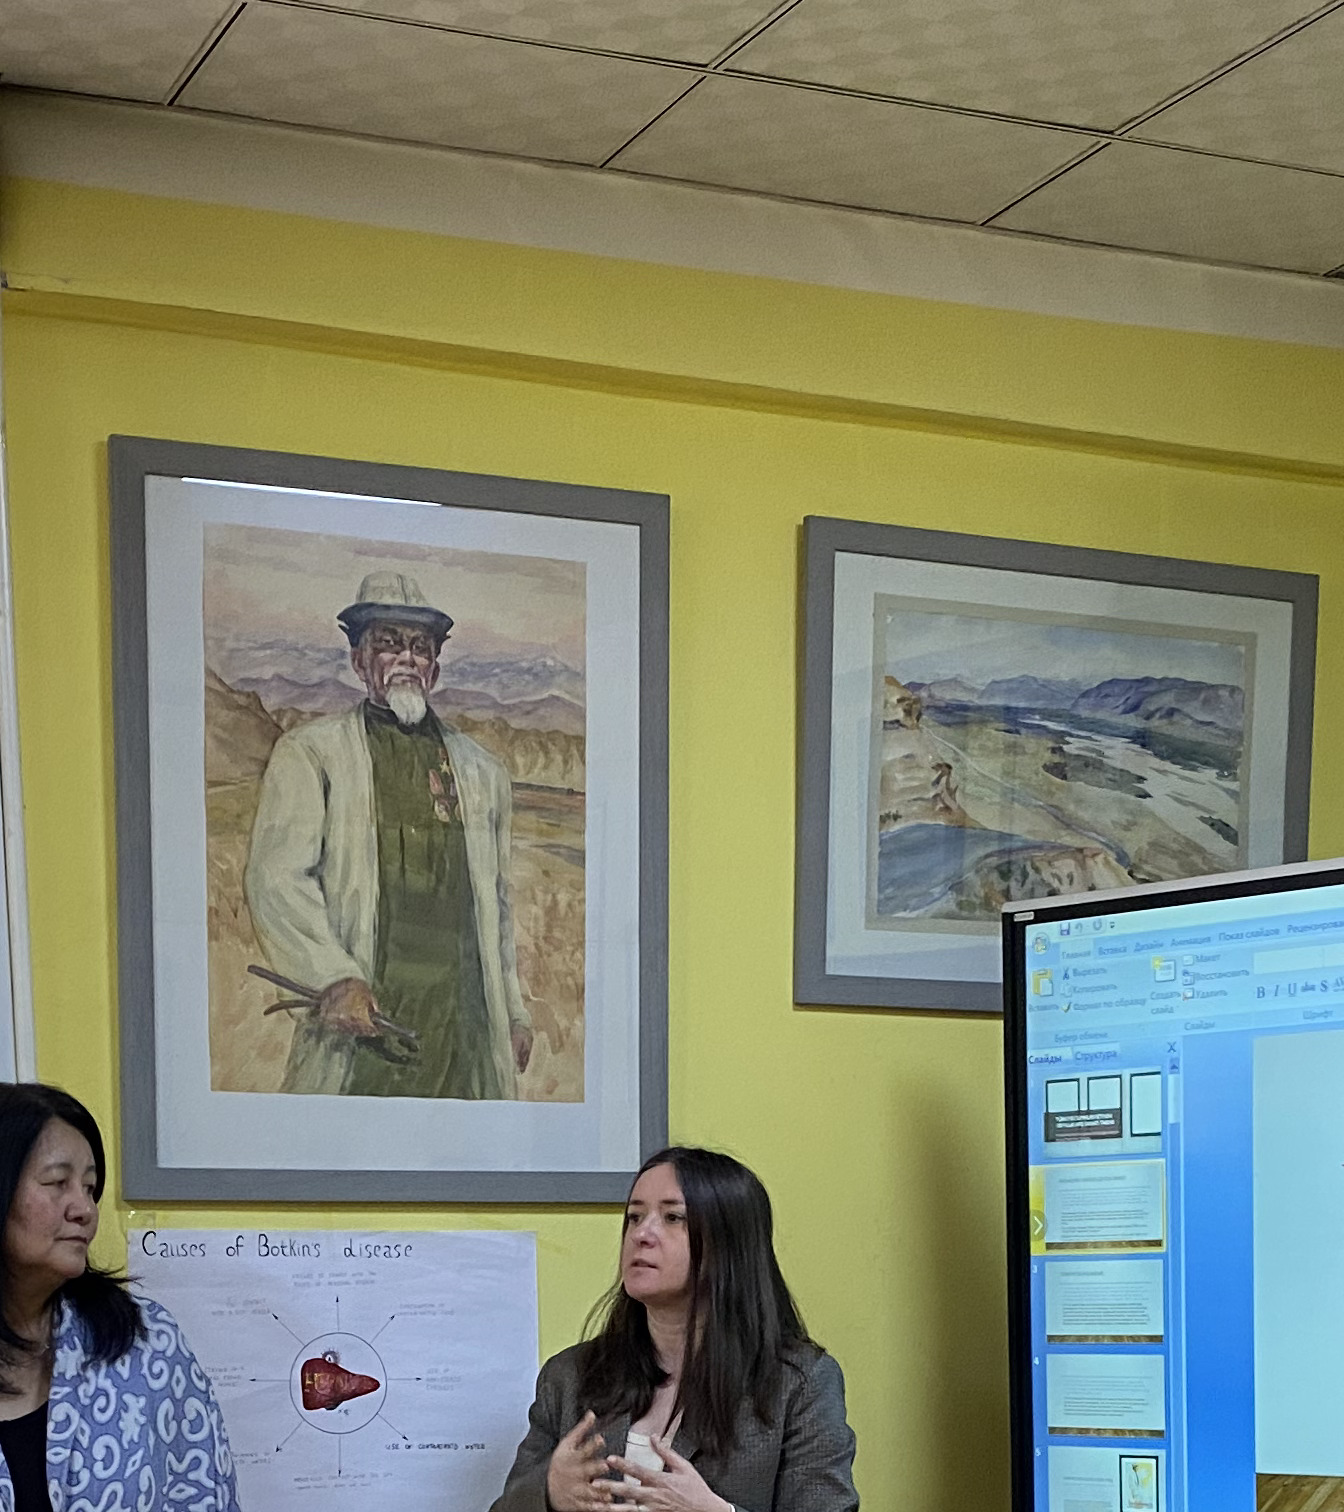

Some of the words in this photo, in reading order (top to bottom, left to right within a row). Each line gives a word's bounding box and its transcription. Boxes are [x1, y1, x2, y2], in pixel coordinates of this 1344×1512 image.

[1028, 1053, 1063, 1066] Слайды
[1074, 1048, 1118, 1064] Структура
[142, 1230, 206, 1259] Causes
[226, 1234, 244, 1258] of
[344, 1235, 413, 1259] disease
